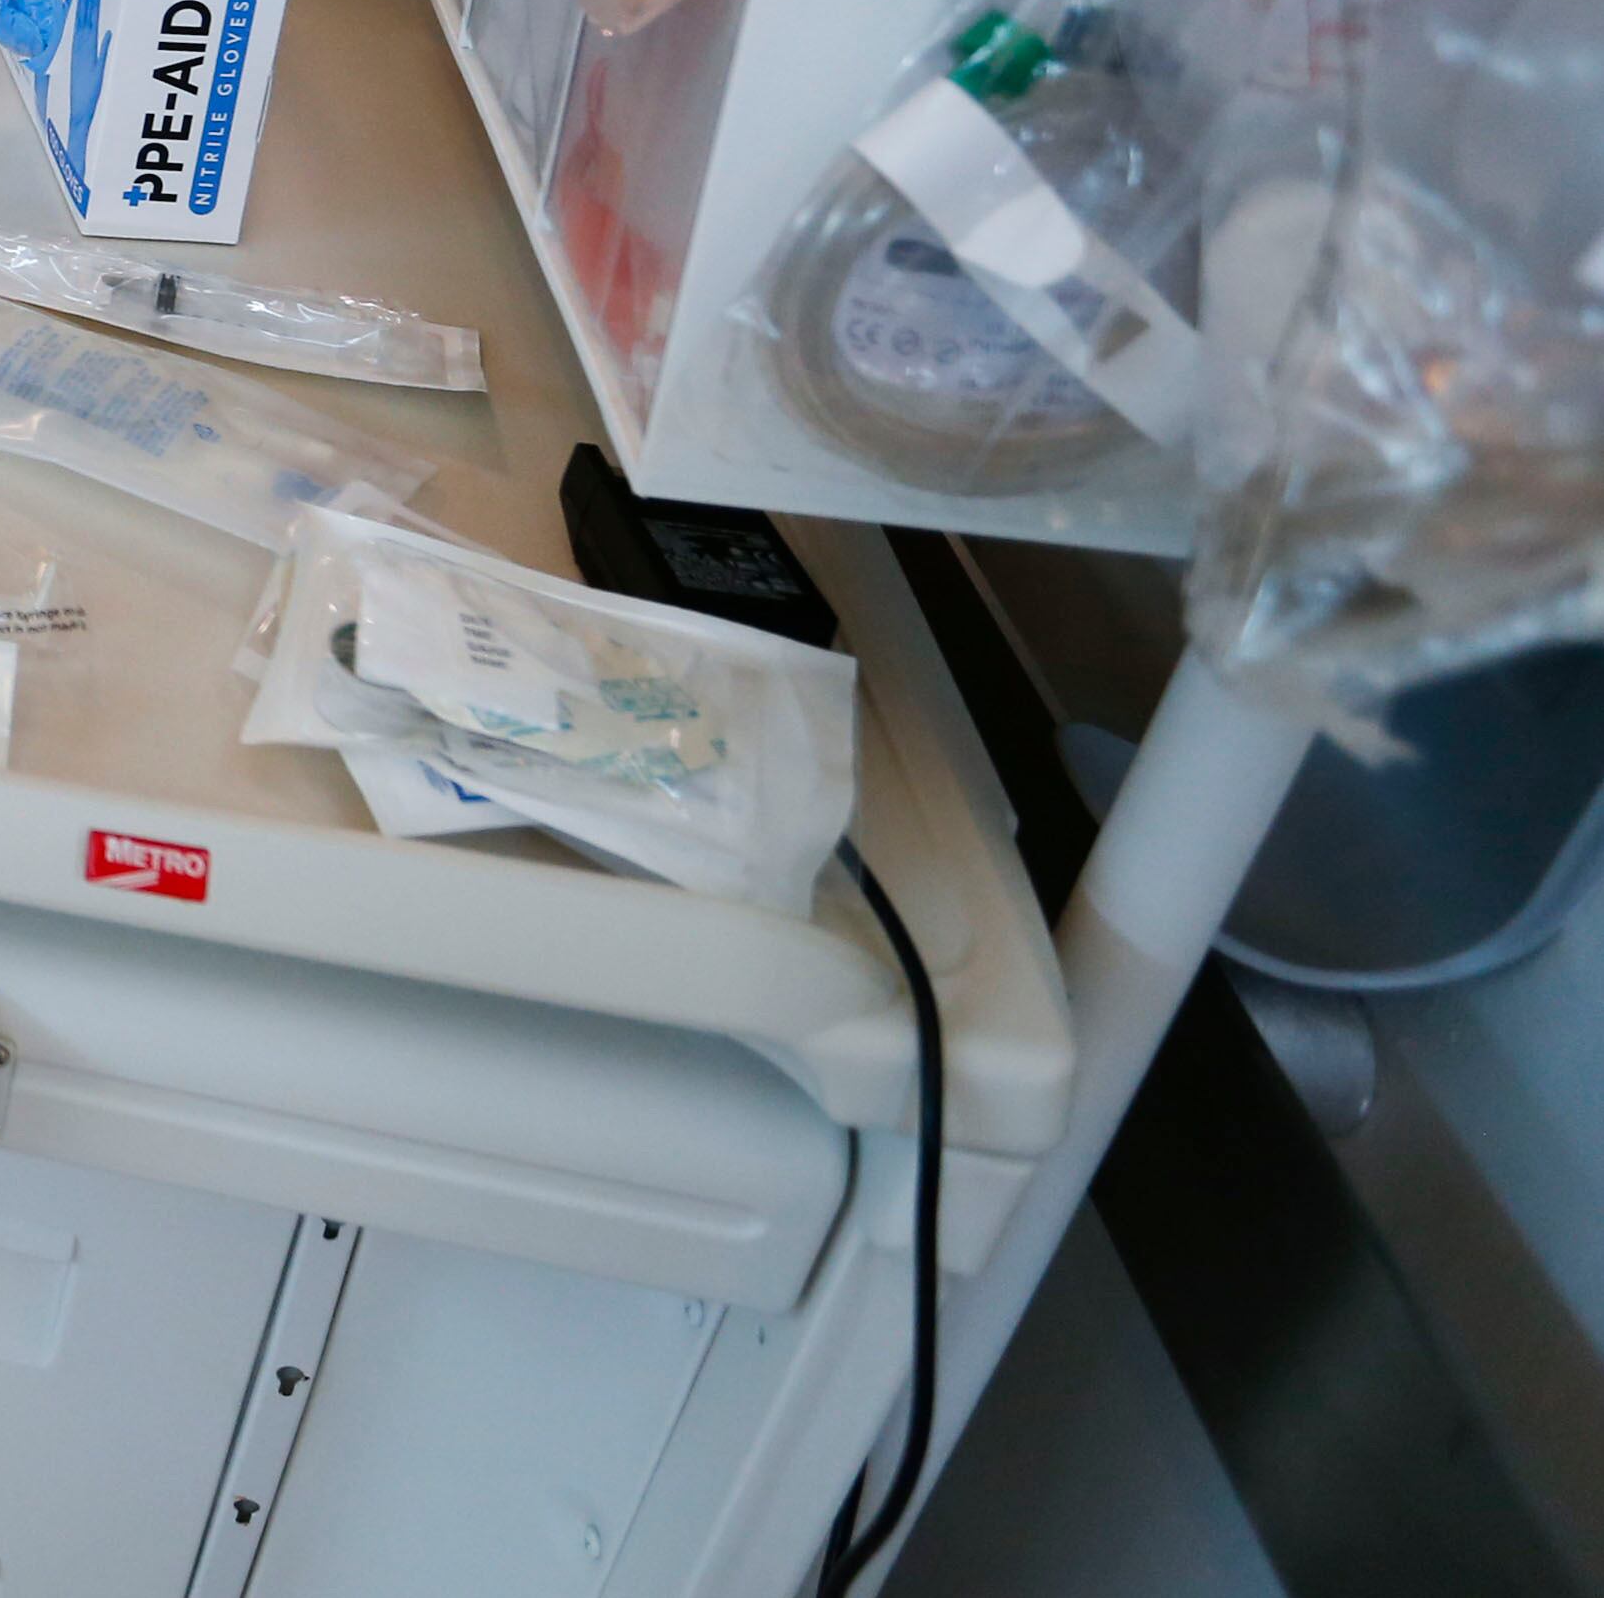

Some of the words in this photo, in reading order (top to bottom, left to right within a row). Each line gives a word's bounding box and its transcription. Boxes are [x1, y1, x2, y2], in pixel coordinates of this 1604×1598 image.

[134, 0, 212, 203] PPE-AID
[195, 112, 227, 206] NITRILE
[217, 0, 249, 96] GLOVES
[105, 836, 206, 879] METRO
